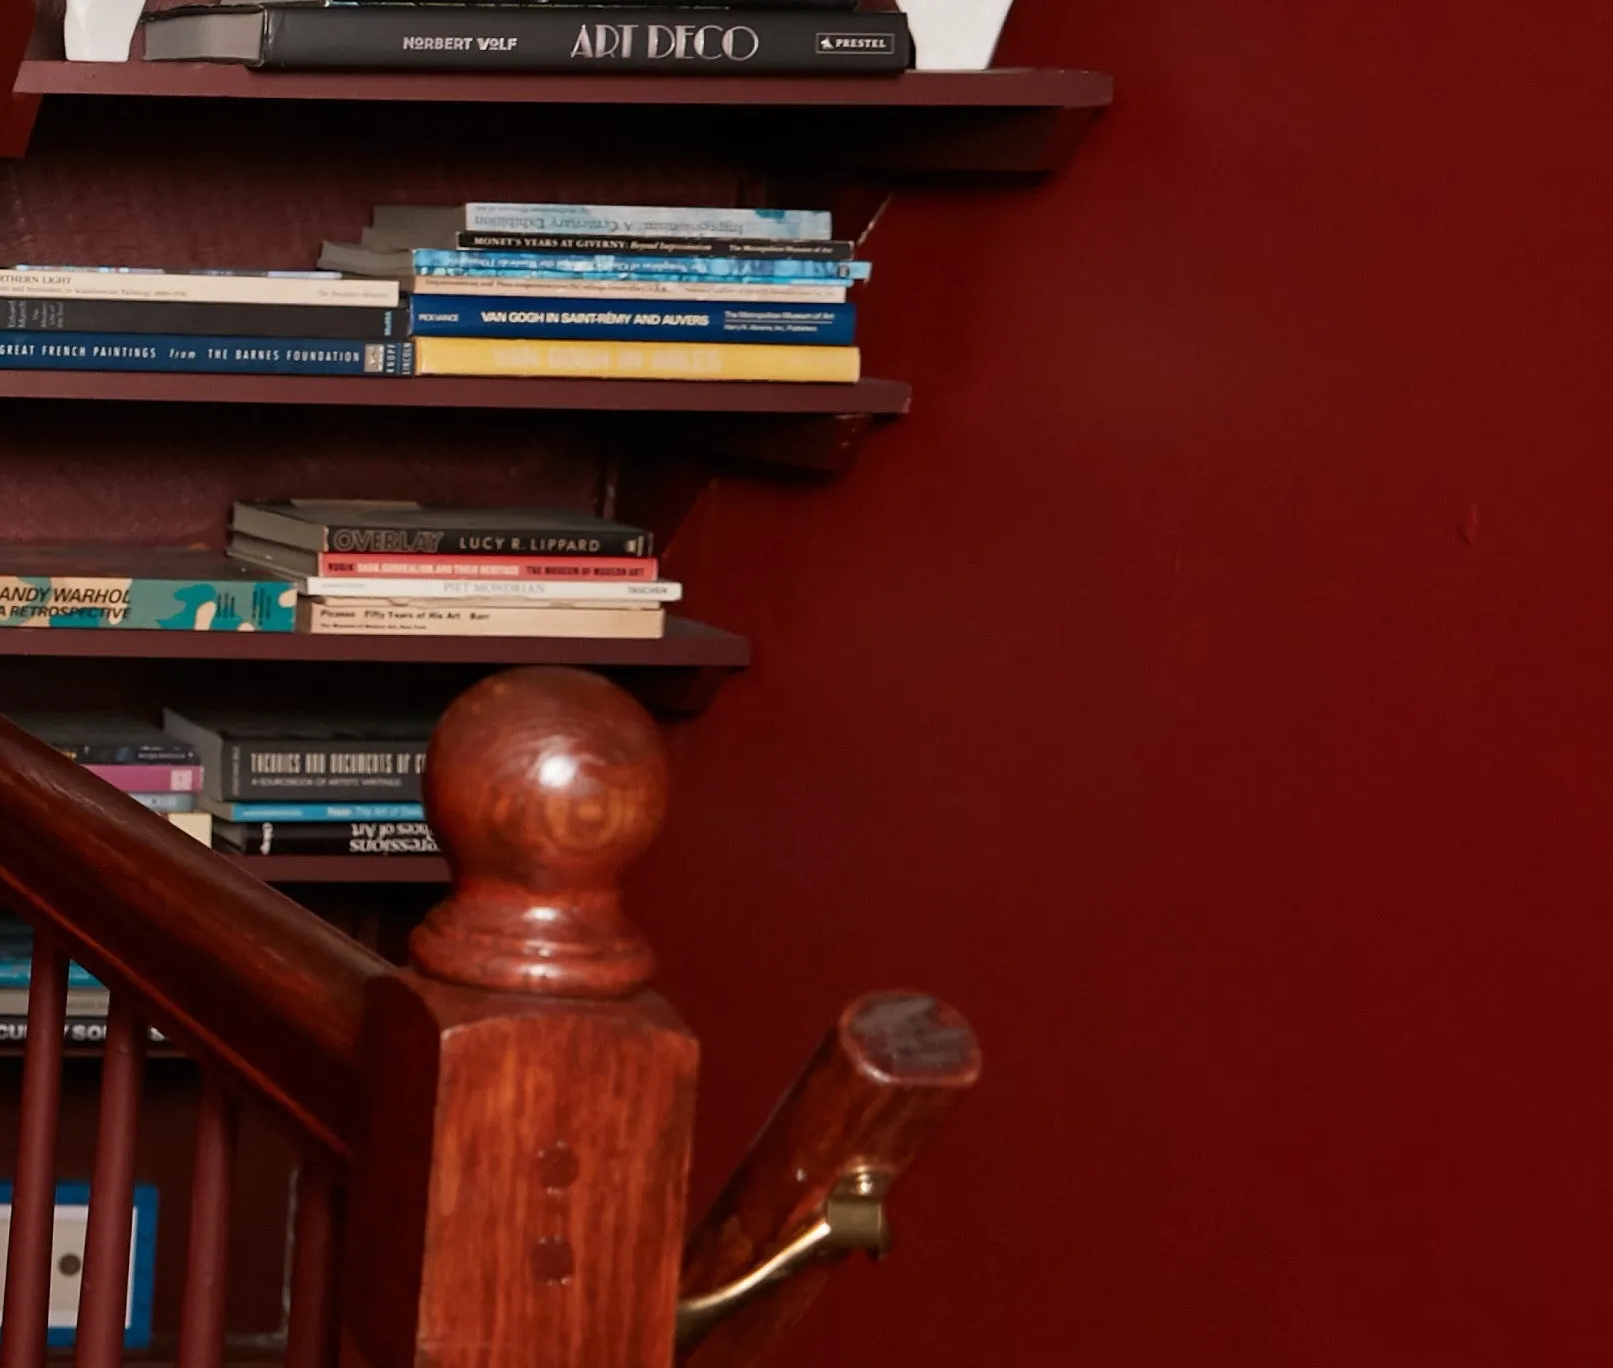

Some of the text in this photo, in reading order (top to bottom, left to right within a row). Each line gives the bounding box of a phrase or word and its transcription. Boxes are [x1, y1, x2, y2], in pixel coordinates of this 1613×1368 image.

[402, 35, 474, 51] NORBERT
[570, 23, 760, 62] ART DECO
[835, 36, 887, 50] PRESTEL
[524, 237, 558, 248] YEARS
[561, 238, 575, 249] AT
[41, 275, 72, 286] LIGHT
[480, 311, 508, 323] VAN
[508, 311, 545, 324] GOGH
[546, 312, 559, 324] IN
[632, 313, 660, 325] AND
[661, 314, 710, 326] AUVERS
[40, 344, 87, 357] FRENCH
[92, 345, 158, 359] PAINTINGS
[169, 347, 197, 360] from
[207, 348, 228, 360] THE
[235, 348, 280, 361] BARNES
[286, 349, 361, 362] FOUNDATION
[386, 343, 396, 373] KNOPF
[333, 528, 446, 553] OVERLAY
[458, 536, 505, 551] LUCY
[529, 538, 602, 553] LIPPARD
[473, 582, 546, 594] MONDRIAN
[51, 587, 132, 605] WARHOL
[8, 606, 132, 620] RETROSPECTIVE
